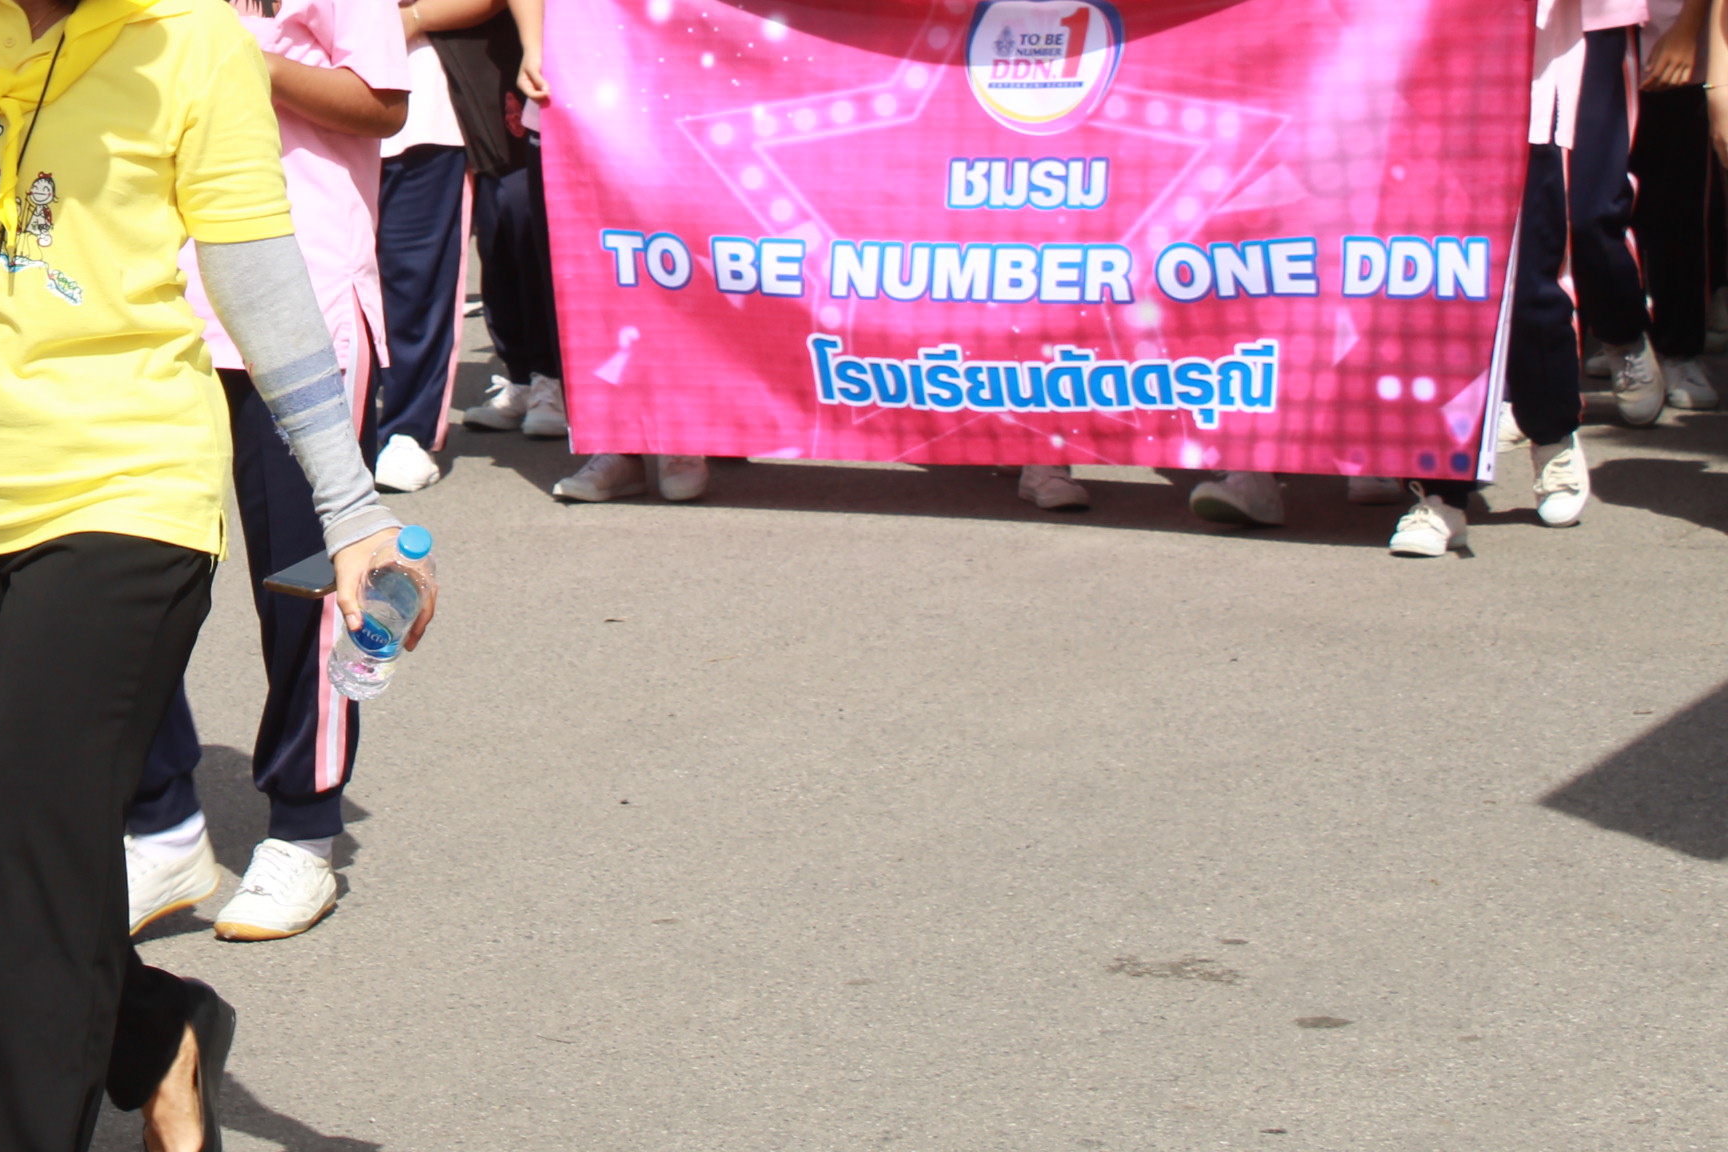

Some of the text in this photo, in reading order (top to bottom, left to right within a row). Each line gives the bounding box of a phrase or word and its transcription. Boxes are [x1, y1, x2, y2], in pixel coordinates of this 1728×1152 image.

[1016, 48, 1062, 56] NUMBER
[1019, 33, 1041, 46] TO
[1044, 33, 1064, 46] BE
[948, 157, 1108, 211] ชมรม
[601, 229, 1491, 304] TO BE NUMBER ONE DDN
[810, 333, 1276, 428] โรงเรียนดัดดรุณี
